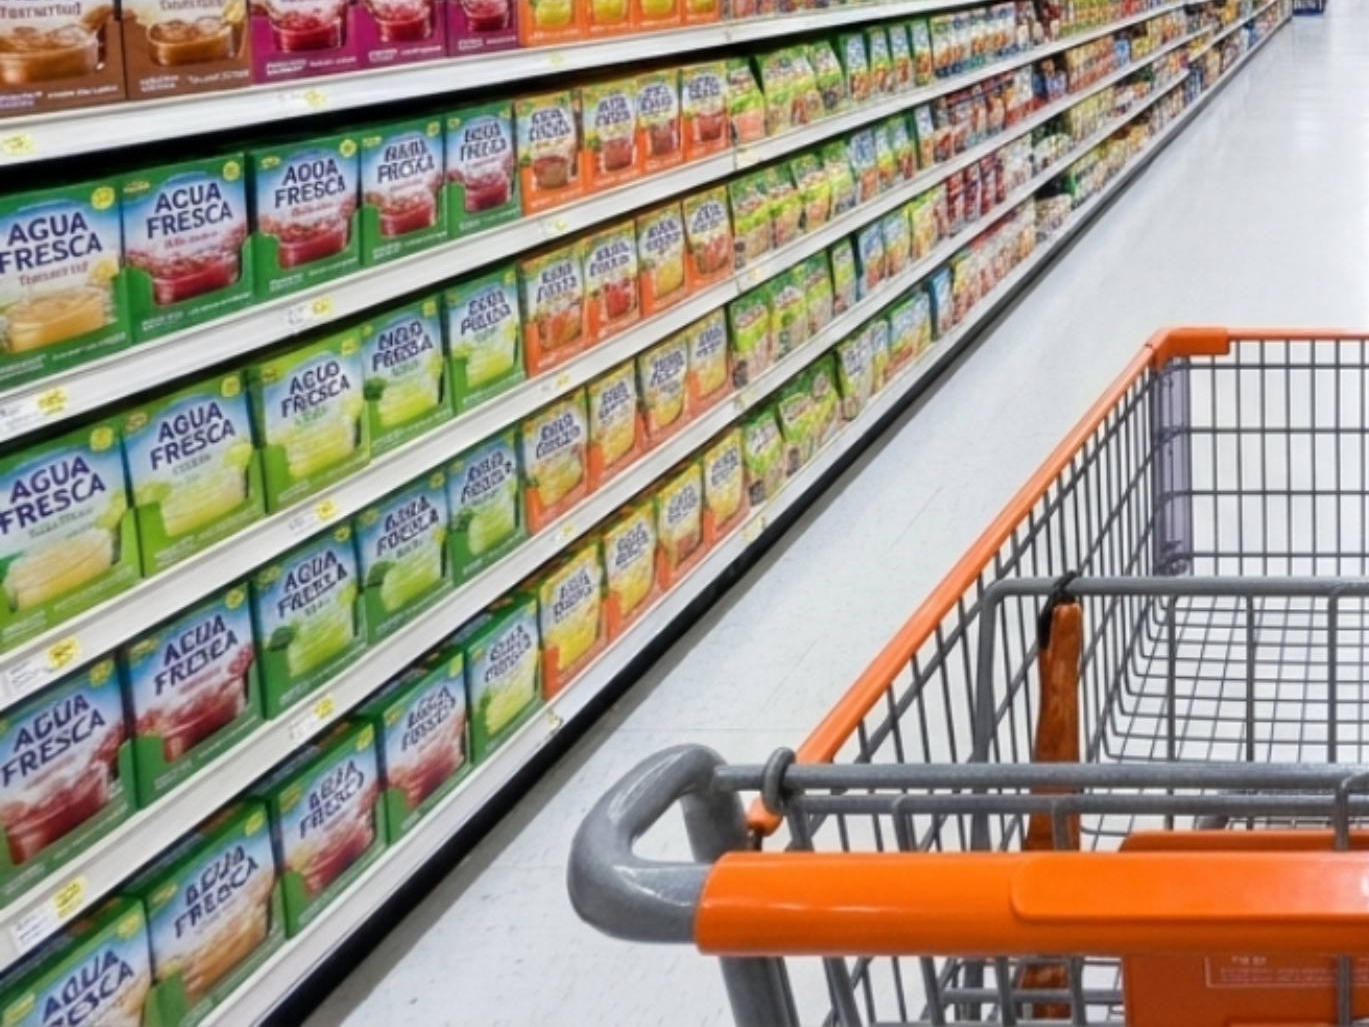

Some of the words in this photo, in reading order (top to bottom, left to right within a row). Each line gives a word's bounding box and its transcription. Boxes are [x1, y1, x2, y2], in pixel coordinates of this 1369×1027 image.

[275, 175, 346, 209] FRESCA
[7, 212, 87, 247] AGUA
[146, 202, 233, 239] FRESCA
[0, 232, 102, 273] FRESCA
[158, 401, 223, 443] AGUA
[150, 419, 235, 470] FRESCA
[10, 456, 90, 504] AGUA
[0, 472, 106, 534] FRESCA
[1, 709, 106, 787] FRESCA
